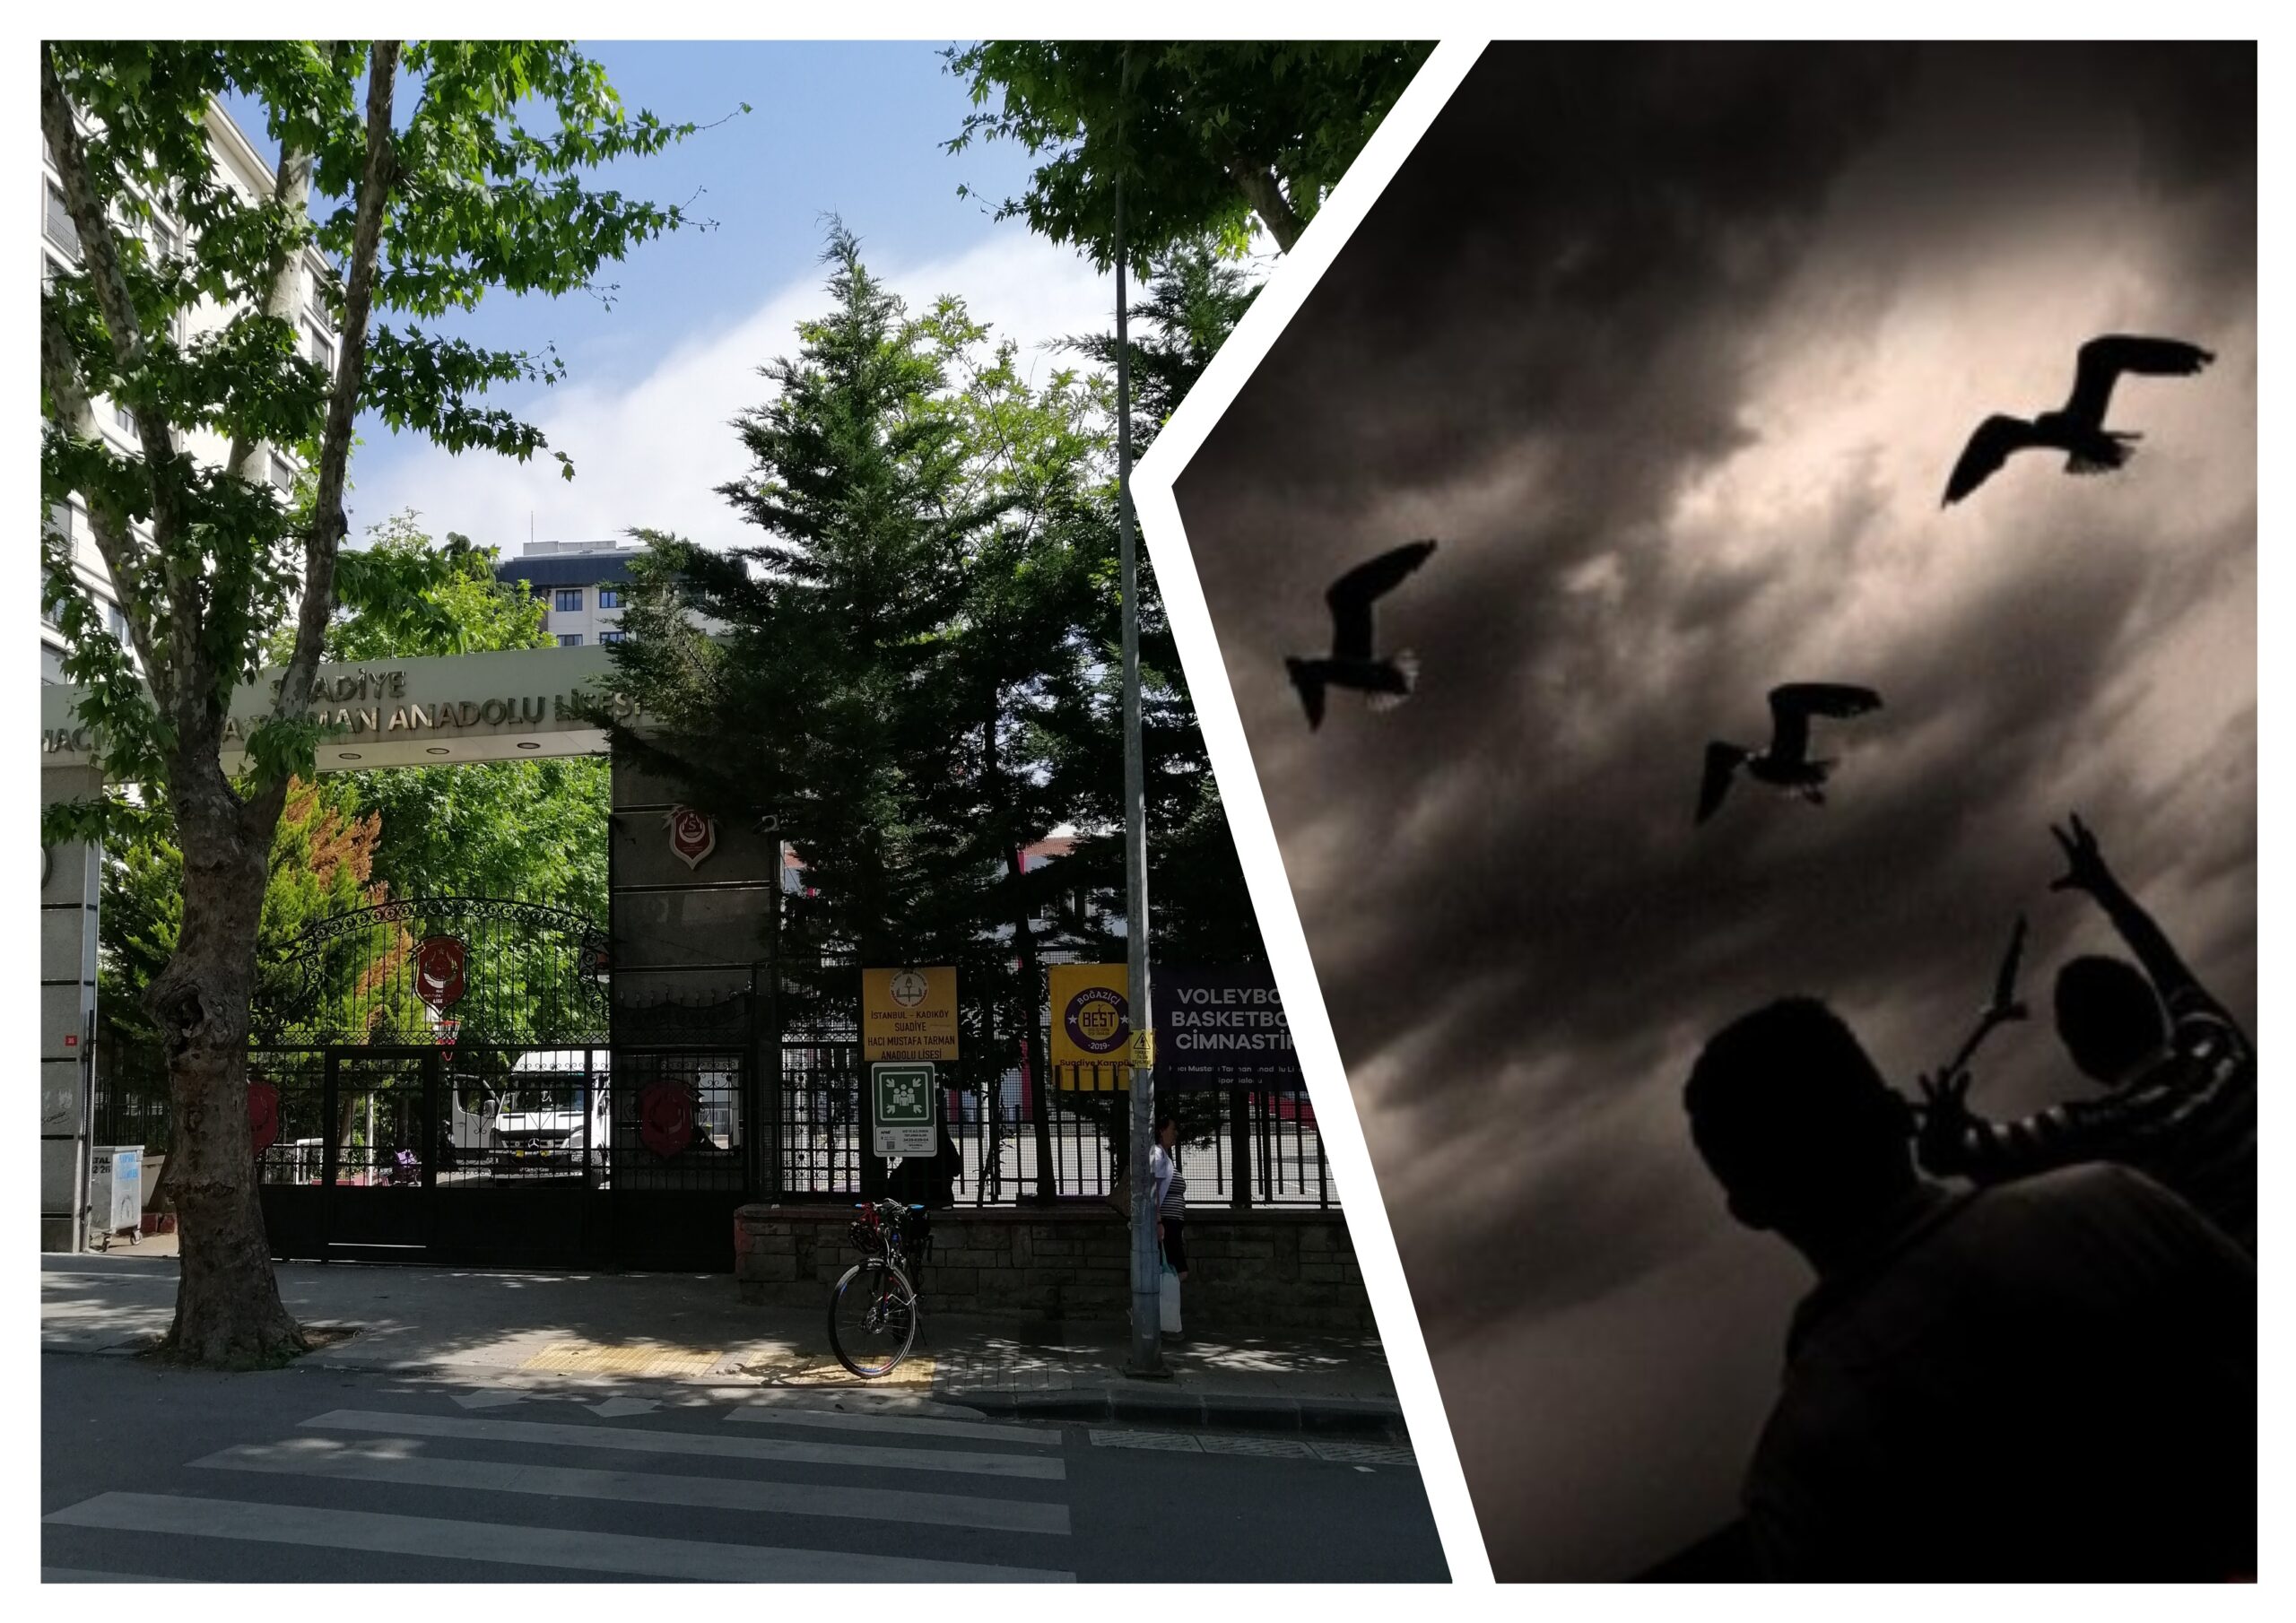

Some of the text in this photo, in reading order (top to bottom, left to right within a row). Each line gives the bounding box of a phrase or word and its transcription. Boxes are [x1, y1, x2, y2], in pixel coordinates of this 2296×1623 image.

[387, 695, 545, 731] ANADOLU
[1076, 991, 1121, 1005] BOĞAZİÇİ
[1177, 988, 1282, 1004] VOLEYBO
[871, 1010, 907, 1020] İSTANBUL
[916, 1010, 949, 1019] KADIKÖY
[1083, 1012, 1116, 1028] BEST
[1171, 1011, 1289, 1027] BASKETBO
[894, 1020, 926, 1032] SUADİYE
[867, 1036, 955, 1046] HACI MUSTAFA TARMAN
[1091, 1042, 1108, 1050] 2019
[881, 1048, 942, 1060] ANADOLU LİSESİ
